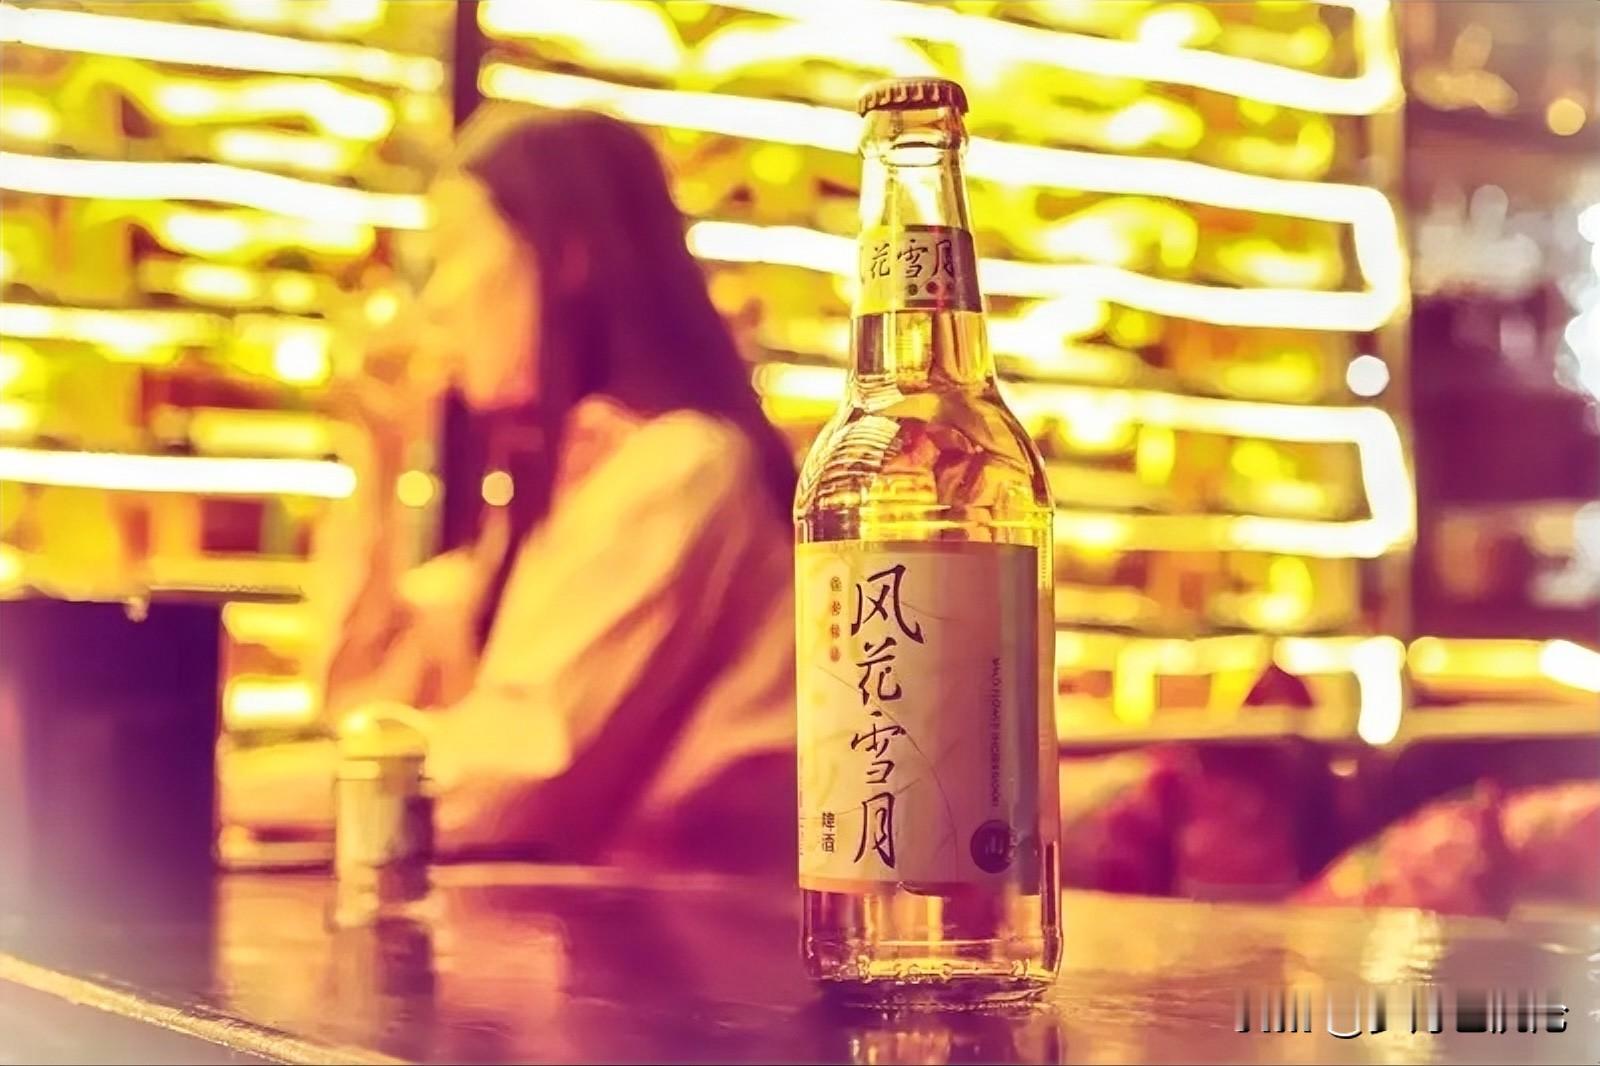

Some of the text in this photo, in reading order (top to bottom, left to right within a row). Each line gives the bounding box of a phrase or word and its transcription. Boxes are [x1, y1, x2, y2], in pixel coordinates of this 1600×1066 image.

[860, 239, 955, 283] 花雪月
[850, 564, 924, 869] 风花雪月
